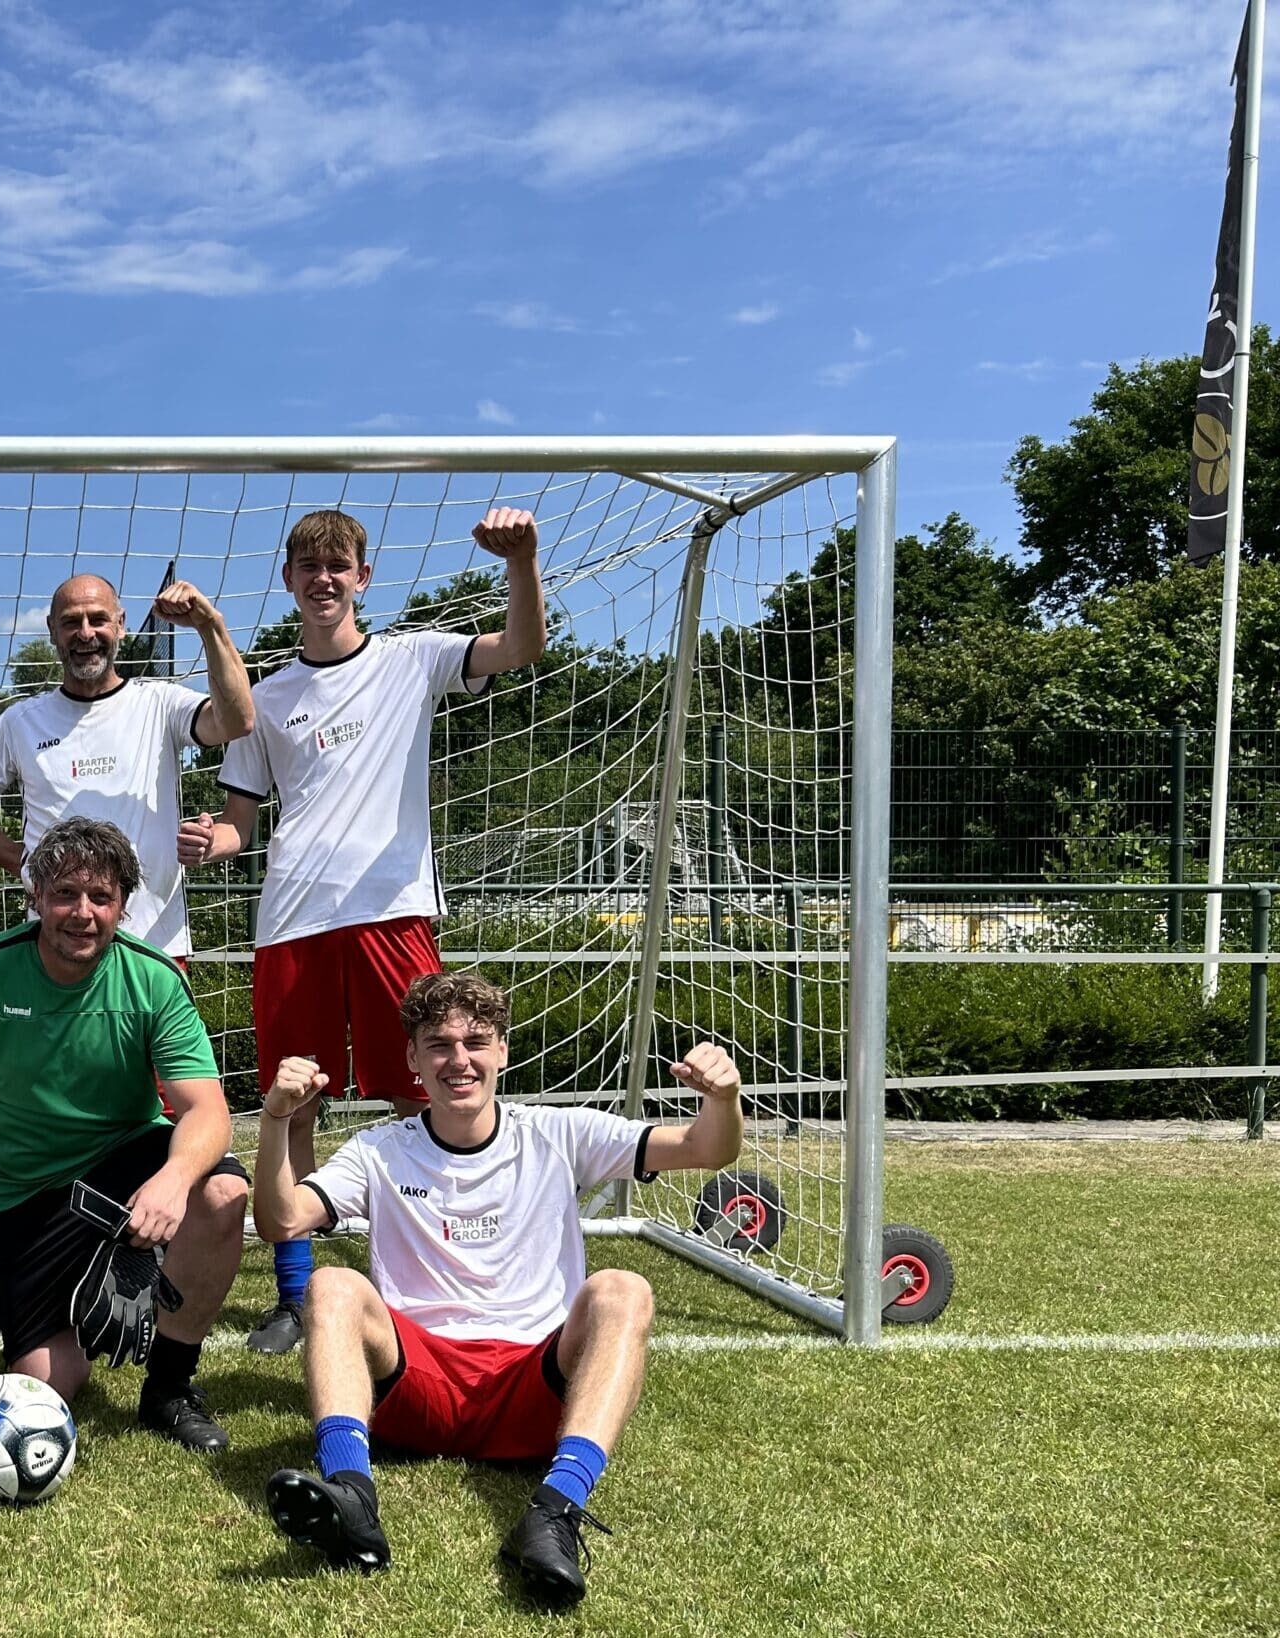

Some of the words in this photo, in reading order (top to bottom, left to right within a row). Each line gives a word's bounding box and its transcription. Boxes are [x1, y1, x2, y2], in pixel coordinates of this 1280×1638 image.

[286, 713, 309, 729] JAKO
[324, 719, 363, 738] BARTEN
[37, 738, 61, 750] JAKO
[326, 730, 362, 747] GROEP
[78, 756, 116, 767] BARTEN
[78, 765, 114, 777] GROEP
[400, 1185, 428, 1199] JAKO
[451, 1215, 499, 1230] BARTEN
[452, 1227, 496, 1241] GROEP
